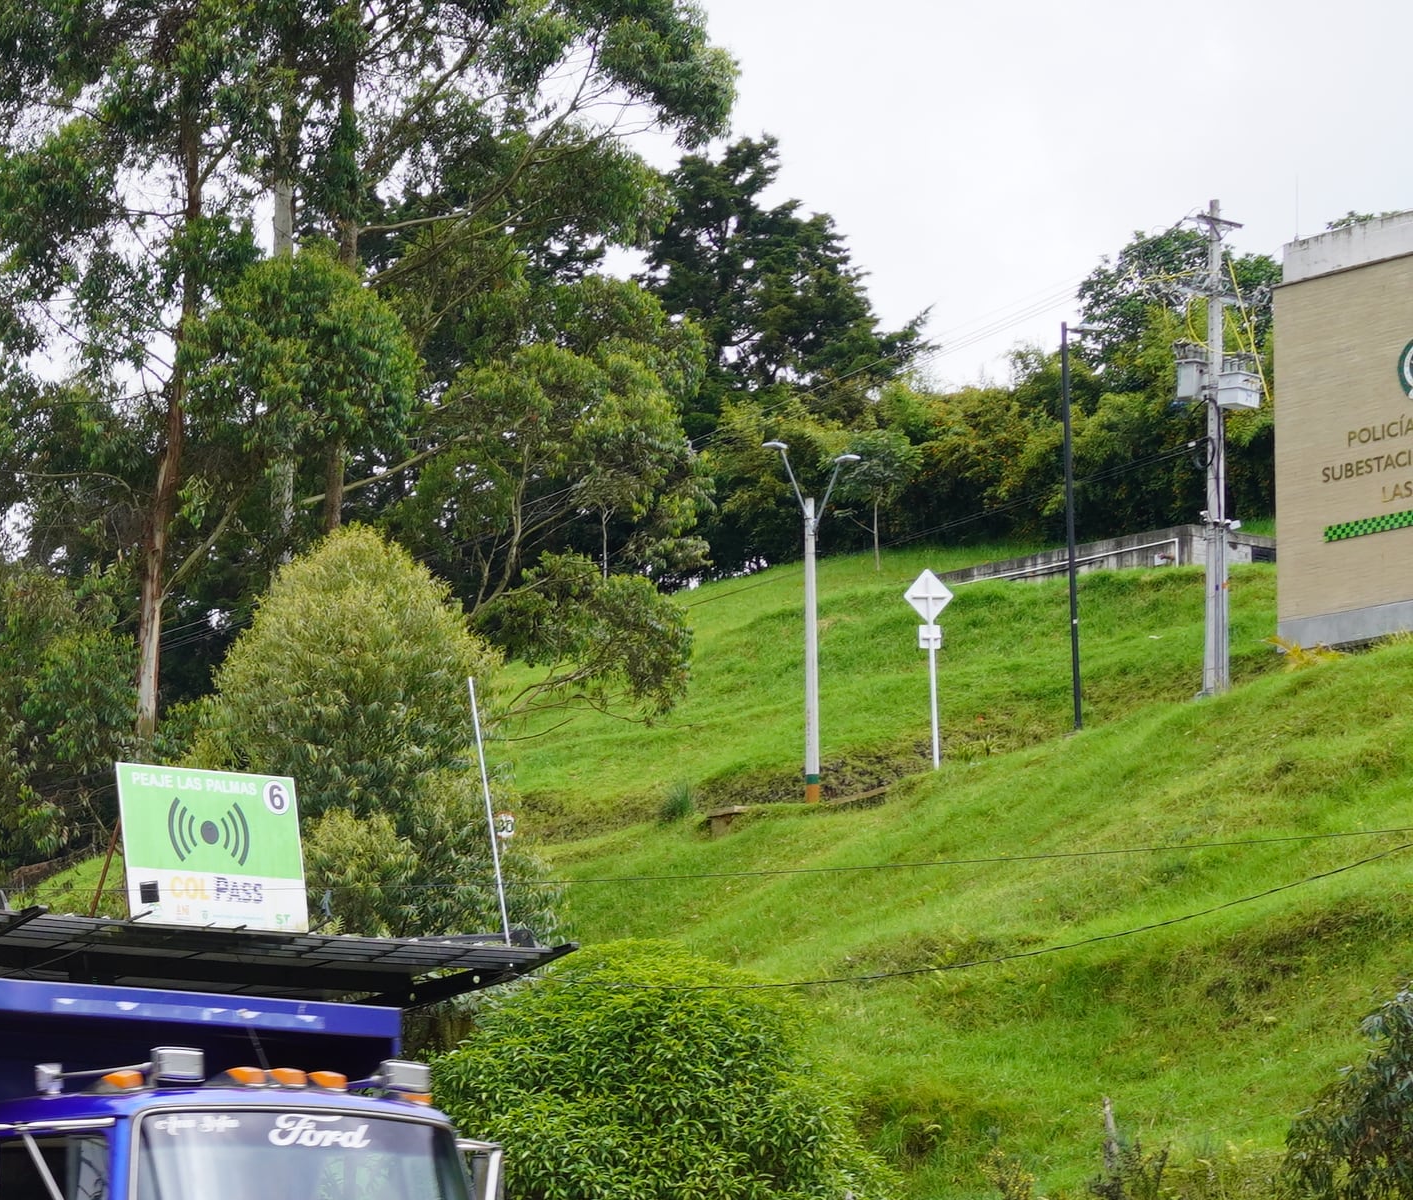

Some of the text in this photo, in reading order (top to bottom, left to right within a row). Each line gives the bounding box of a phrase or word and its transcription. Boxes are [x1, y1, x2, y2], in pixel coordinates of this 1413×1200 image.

[1348, 414, 1413, 447] POLICÍA
[1381, 481, 1413, 503] LAS
[131, 772, 257, 796] PEAJE LAS PALMAS
[268, 784, 285, 810] 6
[268, 1113, 371, 1149] Ford
